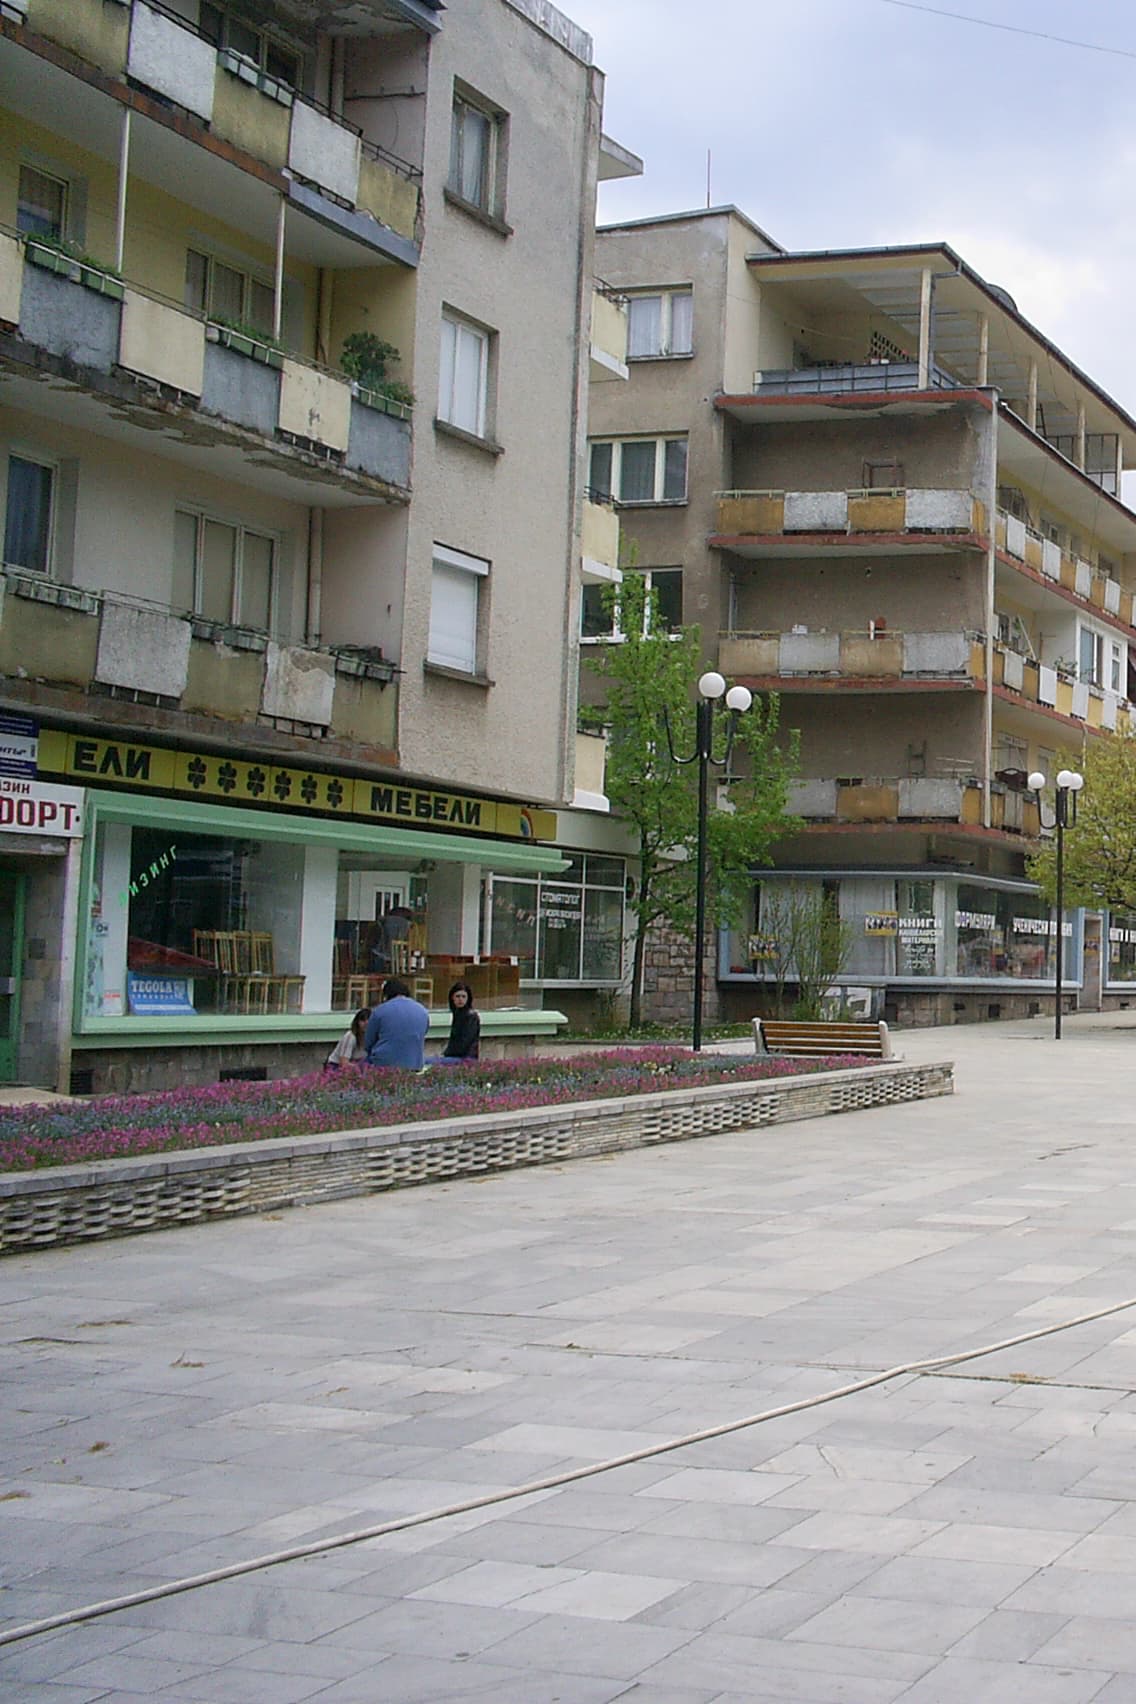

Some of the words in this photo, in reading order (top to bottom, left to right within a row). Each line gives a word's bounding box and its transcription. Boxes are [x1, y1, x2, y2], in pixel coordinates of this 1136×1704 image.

[73, 741, 151, 780] ЕЛИ
[0, 780, 31, 794] ЗИН
[371, 786, 481, 826] МЕБЕЛИ
[131, 979, 174, 994] TEGOLA
